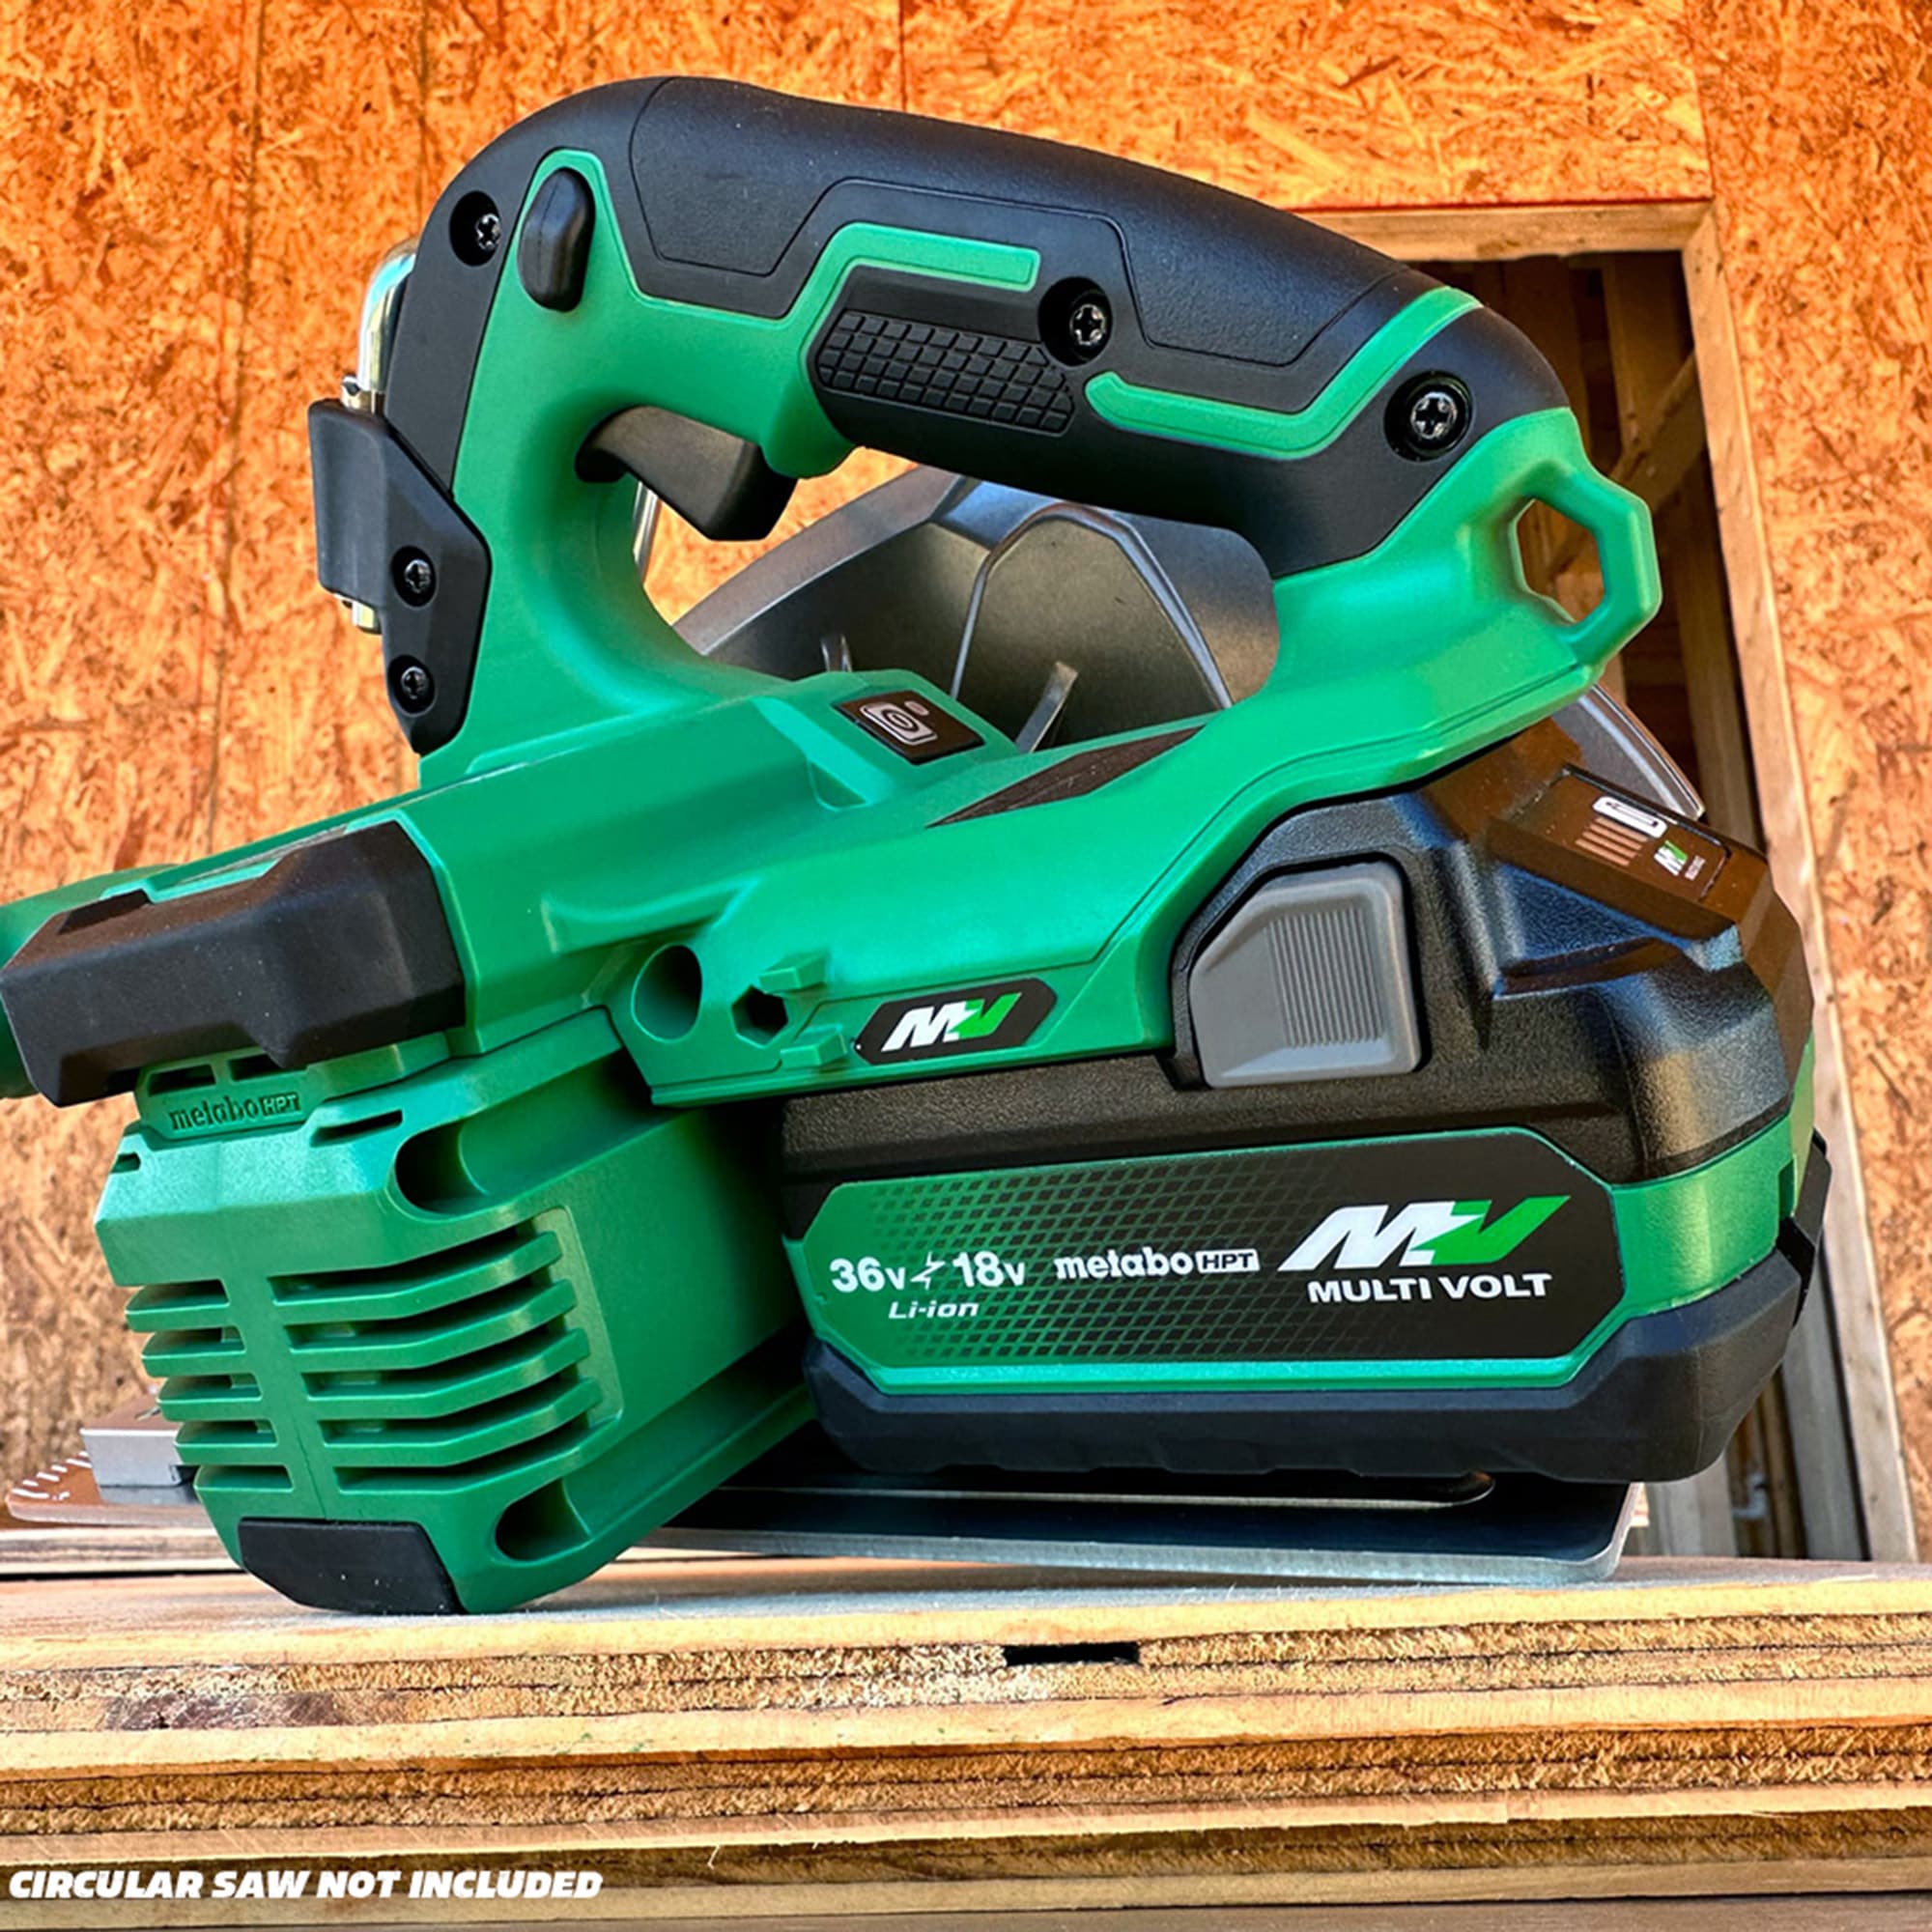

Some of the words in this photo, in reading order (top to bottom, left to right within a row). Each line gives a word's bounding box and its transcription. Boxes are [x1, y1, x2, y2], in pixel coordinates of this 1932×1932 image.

[881, 992, 1023, 1052] MV
[1276, 1195, 1572, 1272] MV
[889, 1300, 980, 1320] Li-ion
[1307, 1277, 1432, 1303] MULTI
[1438, 1272, 1552, 1297] VOLT
